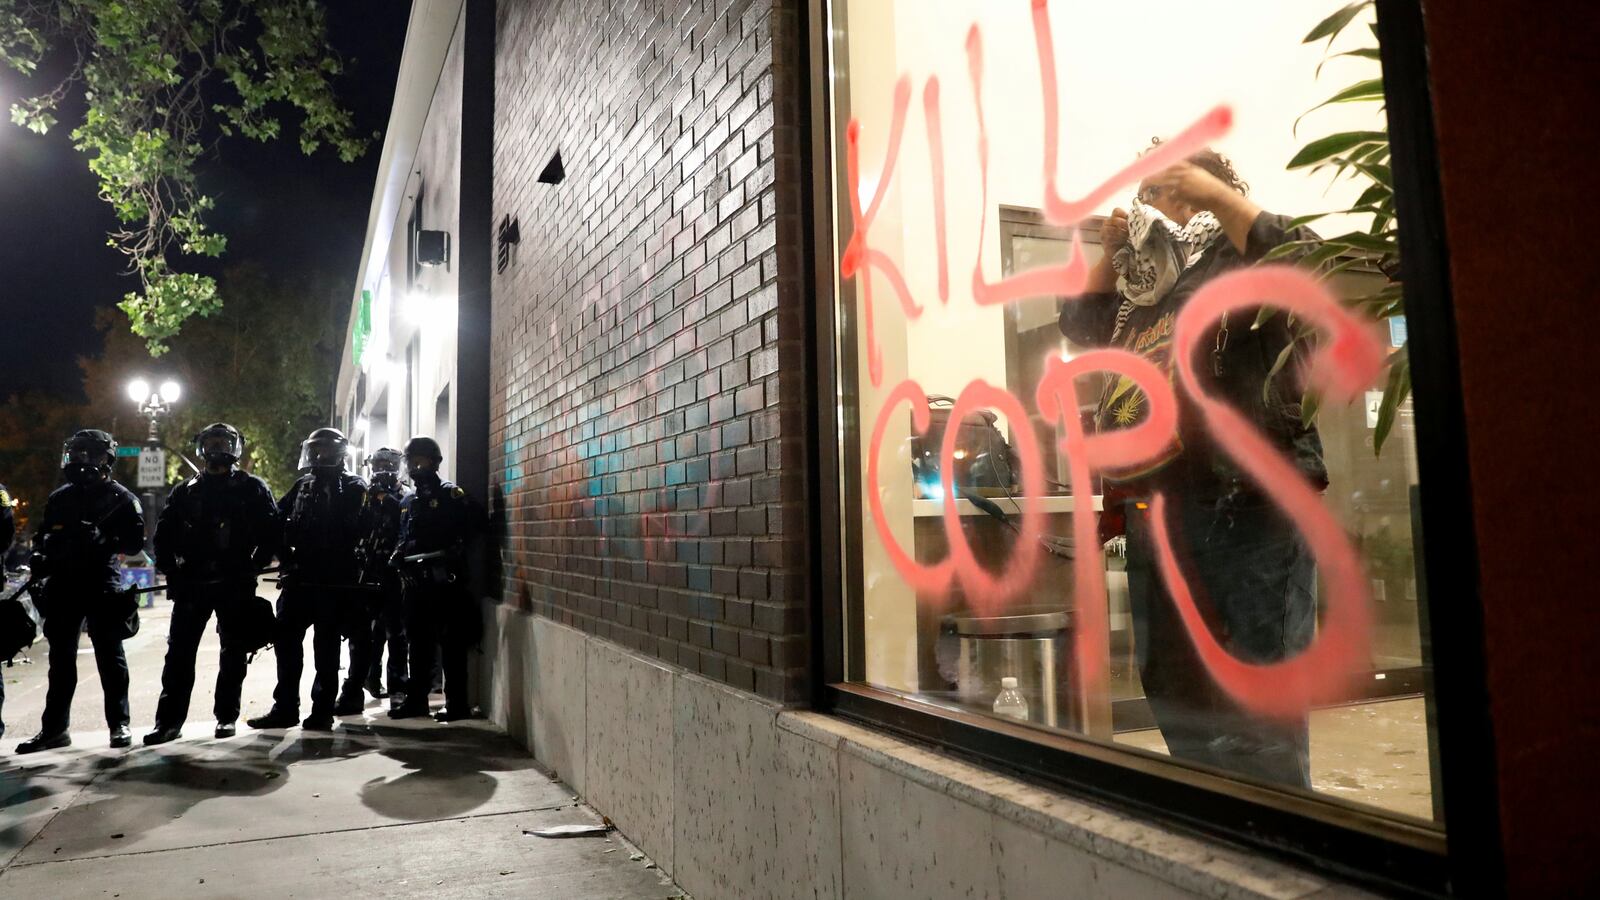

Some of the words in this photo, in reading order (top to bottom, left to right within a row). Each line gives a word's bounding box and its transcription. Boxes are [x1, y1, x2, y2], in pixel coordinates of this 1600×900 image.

[841, 0, 1234, 387] KILL
[144, 456, 159, 464] NO
[868, 265, 1384, 720] COPS
